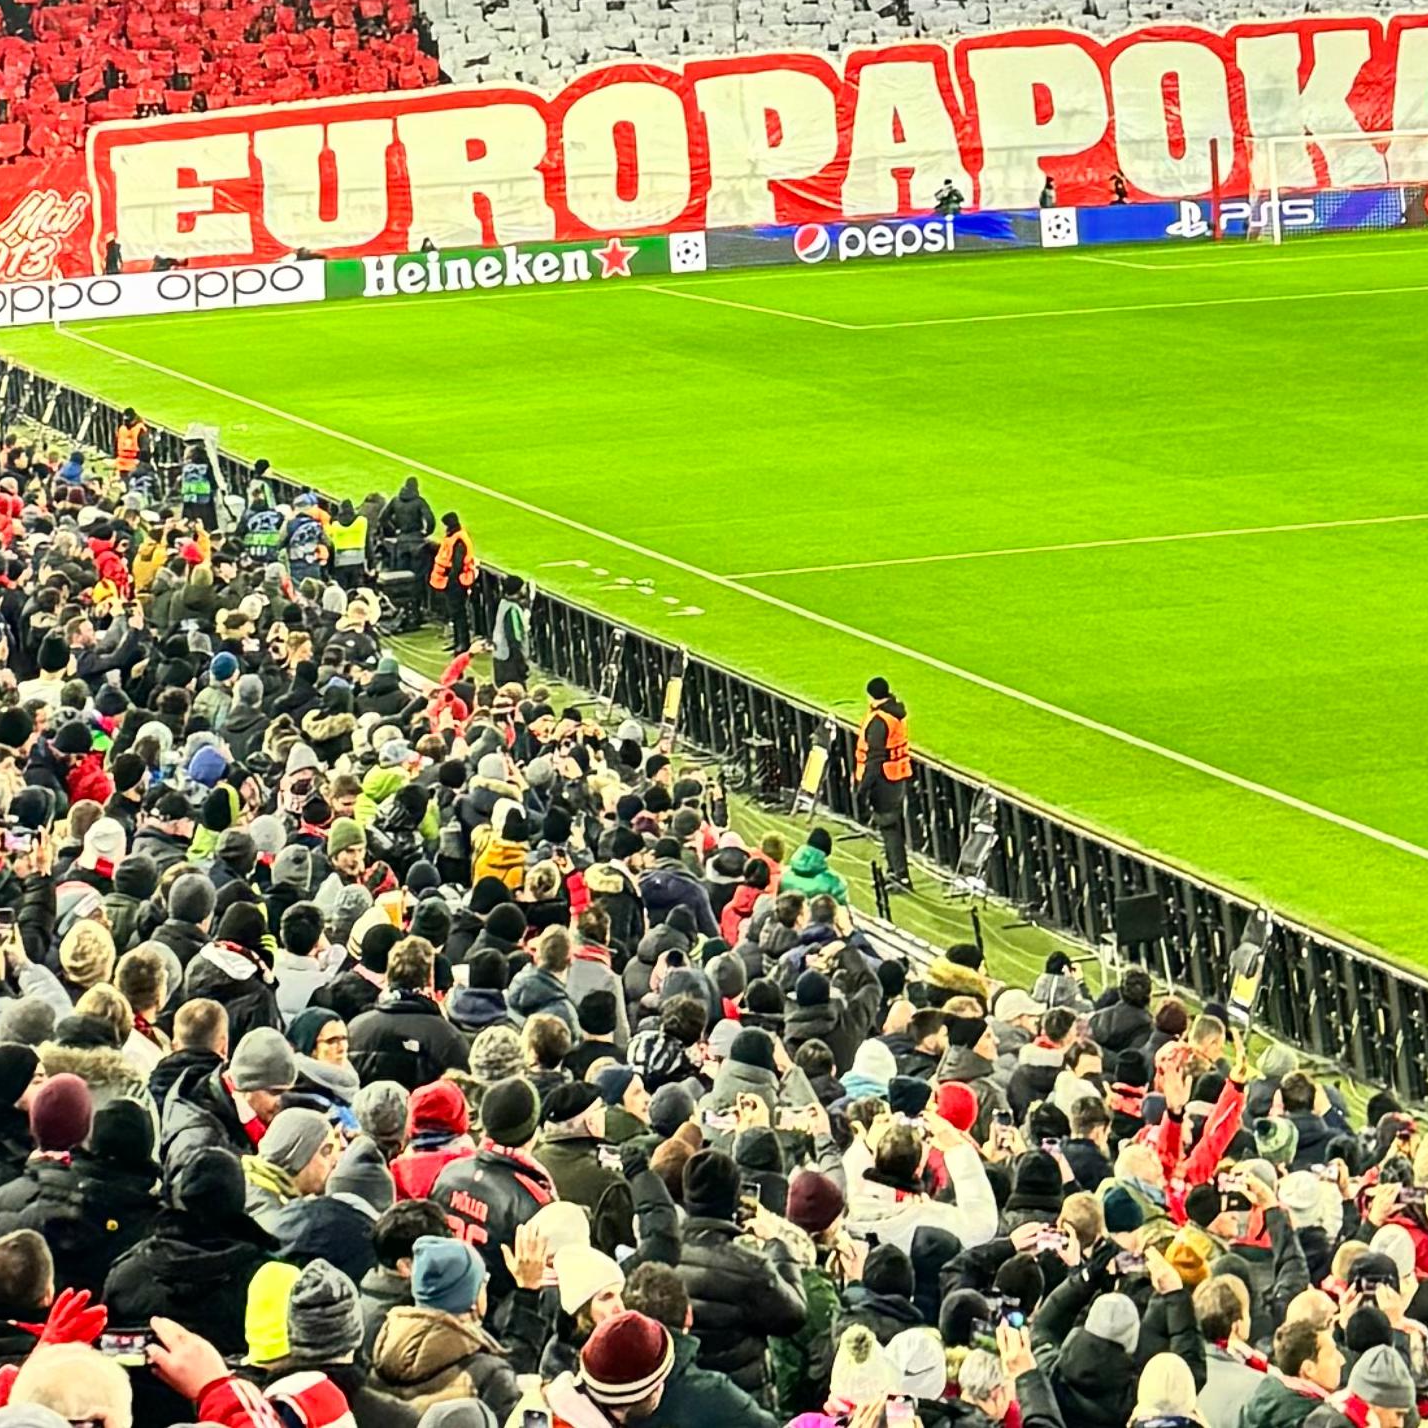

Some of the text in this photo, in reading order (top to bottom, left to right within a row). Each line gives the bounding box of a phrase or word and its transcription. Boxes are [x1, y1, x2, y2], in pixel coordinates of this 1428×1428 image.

[1219, 195, 1315, 231] PS5
[838, 216, 955, 261] pepsi
[157, 263, 304, 308] oppo
[360, 243, 592, 297] Heineken
